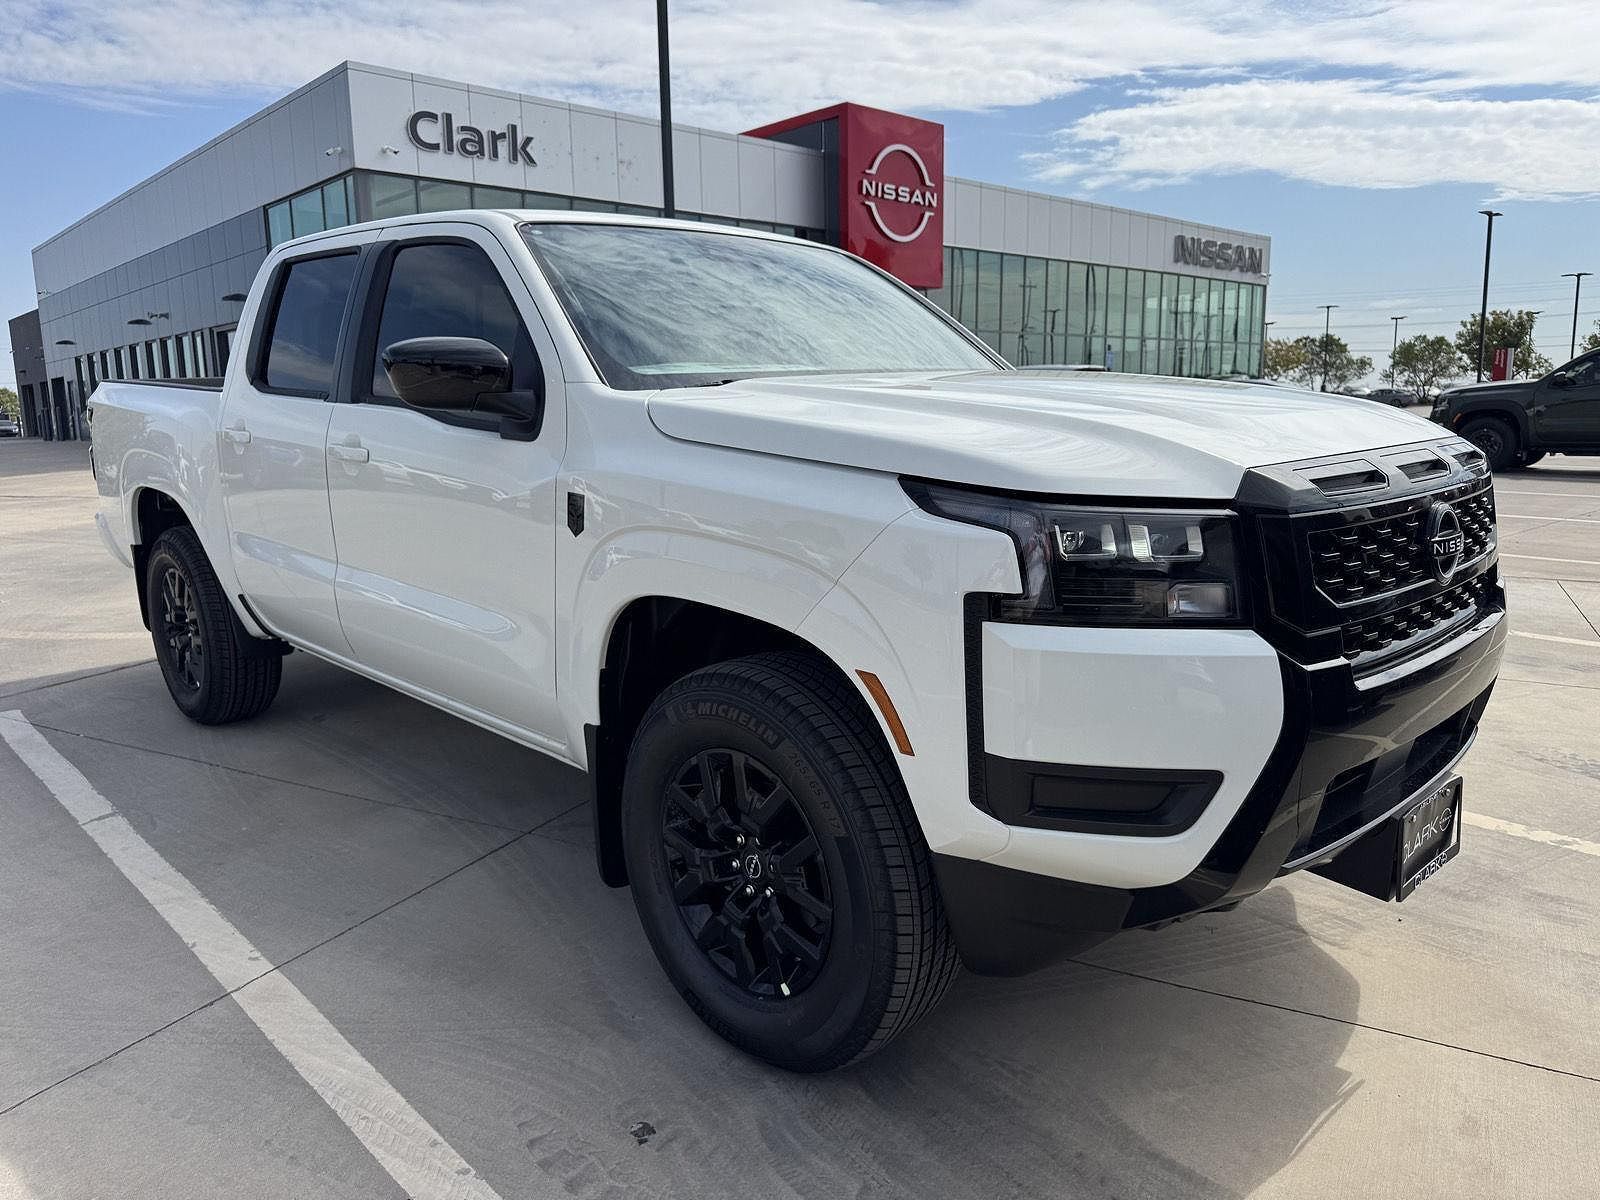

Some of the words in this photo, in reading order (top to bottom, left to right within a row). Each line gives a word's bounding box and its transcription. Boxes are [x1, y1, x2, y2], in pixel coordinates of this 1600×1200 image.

[407, 110, 538, 167] Clark
[862, 178, 937, 208] NISSAN
[1173, 234, 1263, 274] NISSAN
[1433, 538, 1461, 555] NISS
[697, 702, 778, 745] MICHELIN
